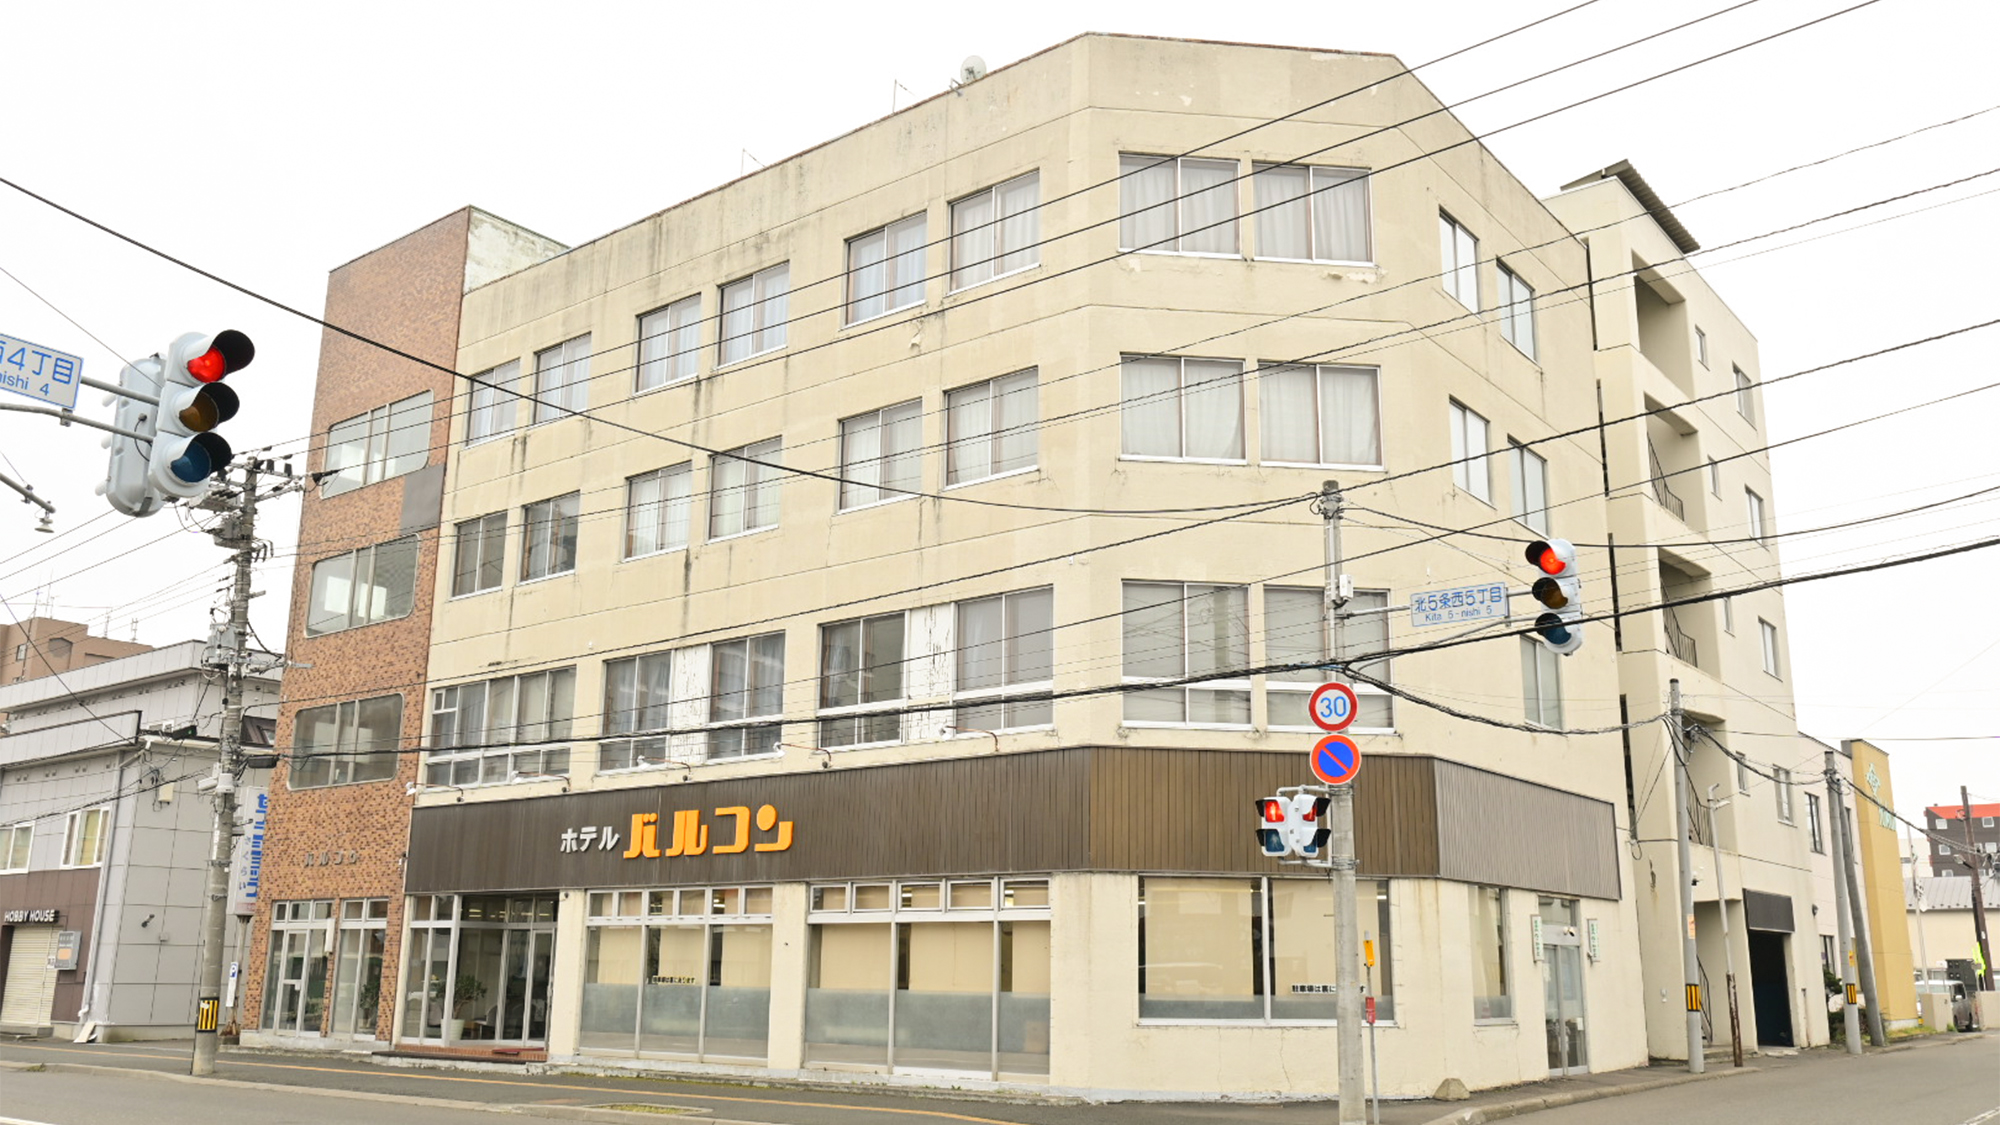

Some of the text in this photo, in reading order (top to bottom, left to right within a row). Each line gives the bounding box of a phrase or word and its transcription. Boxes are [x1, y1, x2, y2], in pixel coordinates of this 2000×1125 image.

[39, 383, 50, 396] 4
[1414, 586, 1502, 613] 北5条西5丁目
[1425, 613, 1442, 622] Kita
[1486, 605, 1492, 615] 5
[1320, 696, 1347, 718] 30
[560, 804, 794, 859] ホテル バルコン
[4, 909, 55, 922] HOBBY HOUSE
